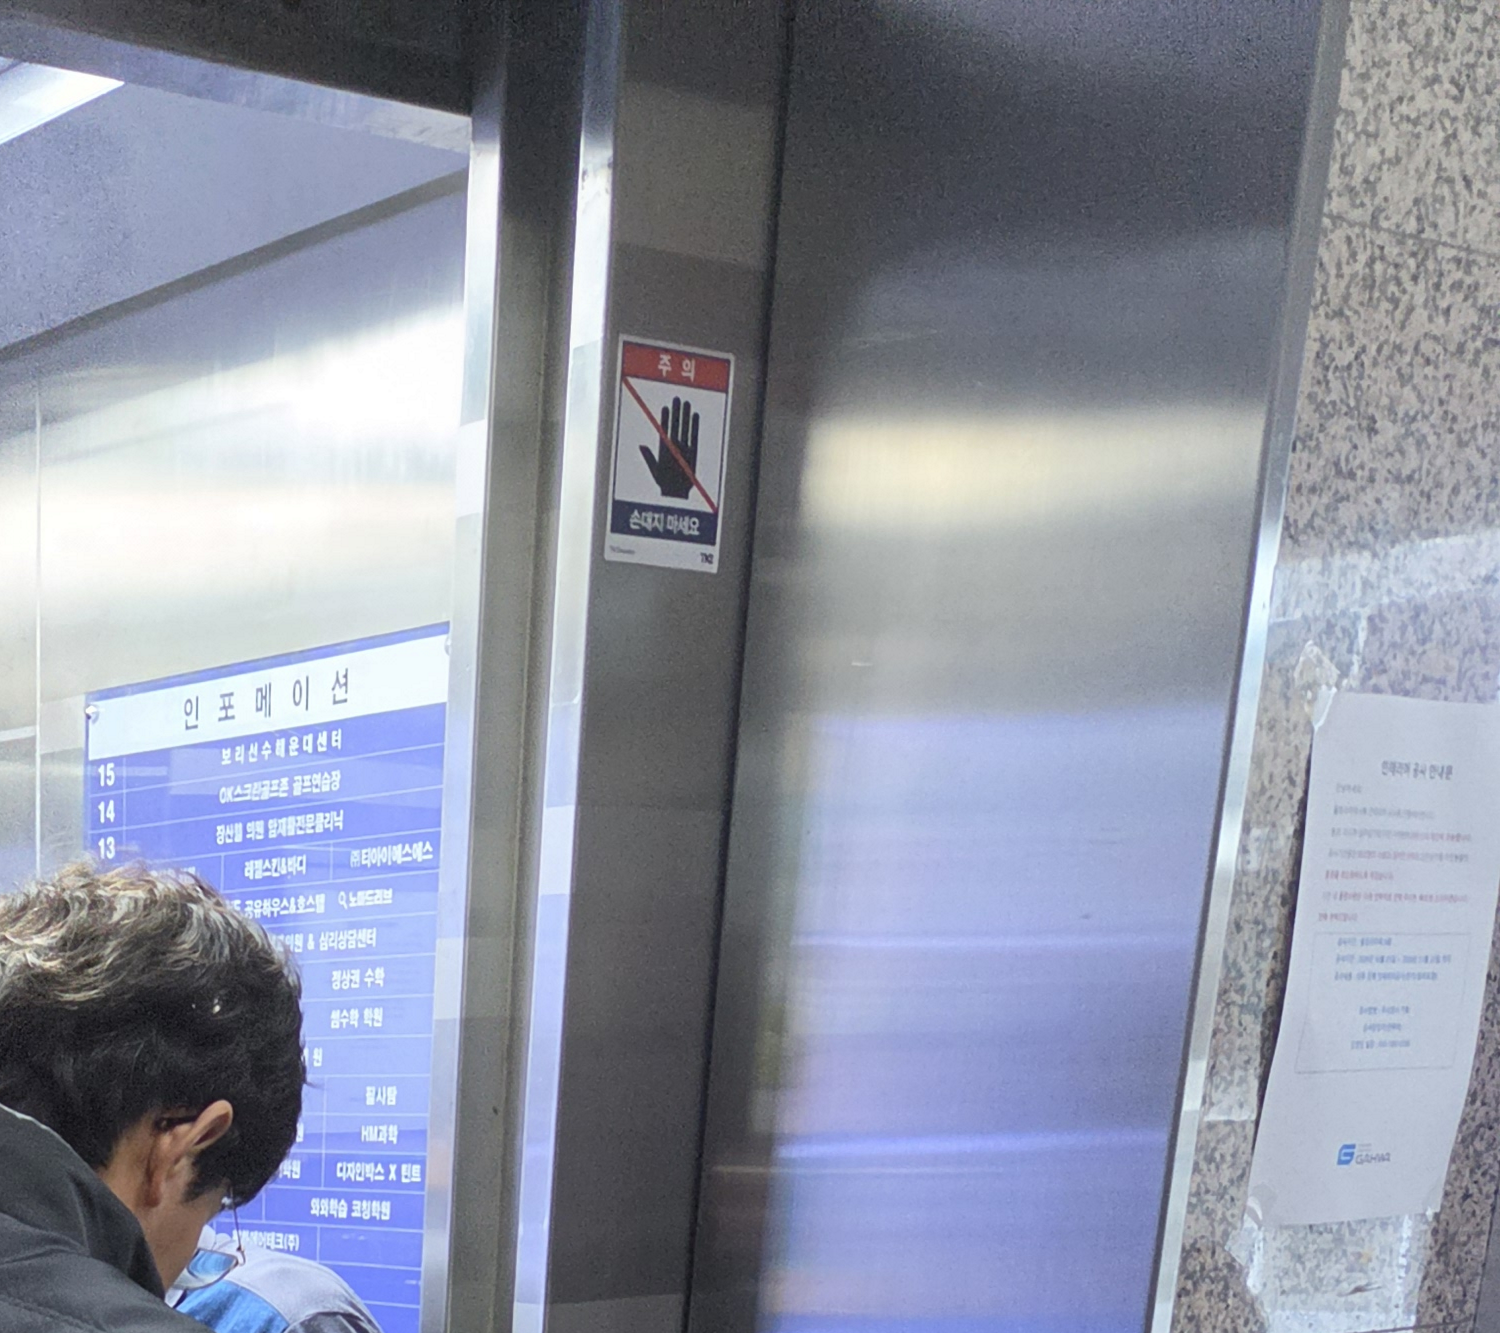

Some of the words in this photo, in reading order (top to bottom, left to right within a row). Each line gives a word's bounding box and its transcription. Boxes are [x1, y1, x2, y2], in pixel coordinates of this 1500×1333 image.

[629, 509, 663, 533] 손대지
[666, 513, 700, 536] 마세요
[98, 763, 115, 788] 15
[98, 800, 115, 824] 14
[98, 837, 115, 860] 13
[307, 932, 315, 951] &
[363, 967, 386, 988] 수학
[363, 1007, 383, 1028] 학원
[336, 1161, 385, 1183] 디자인박스
